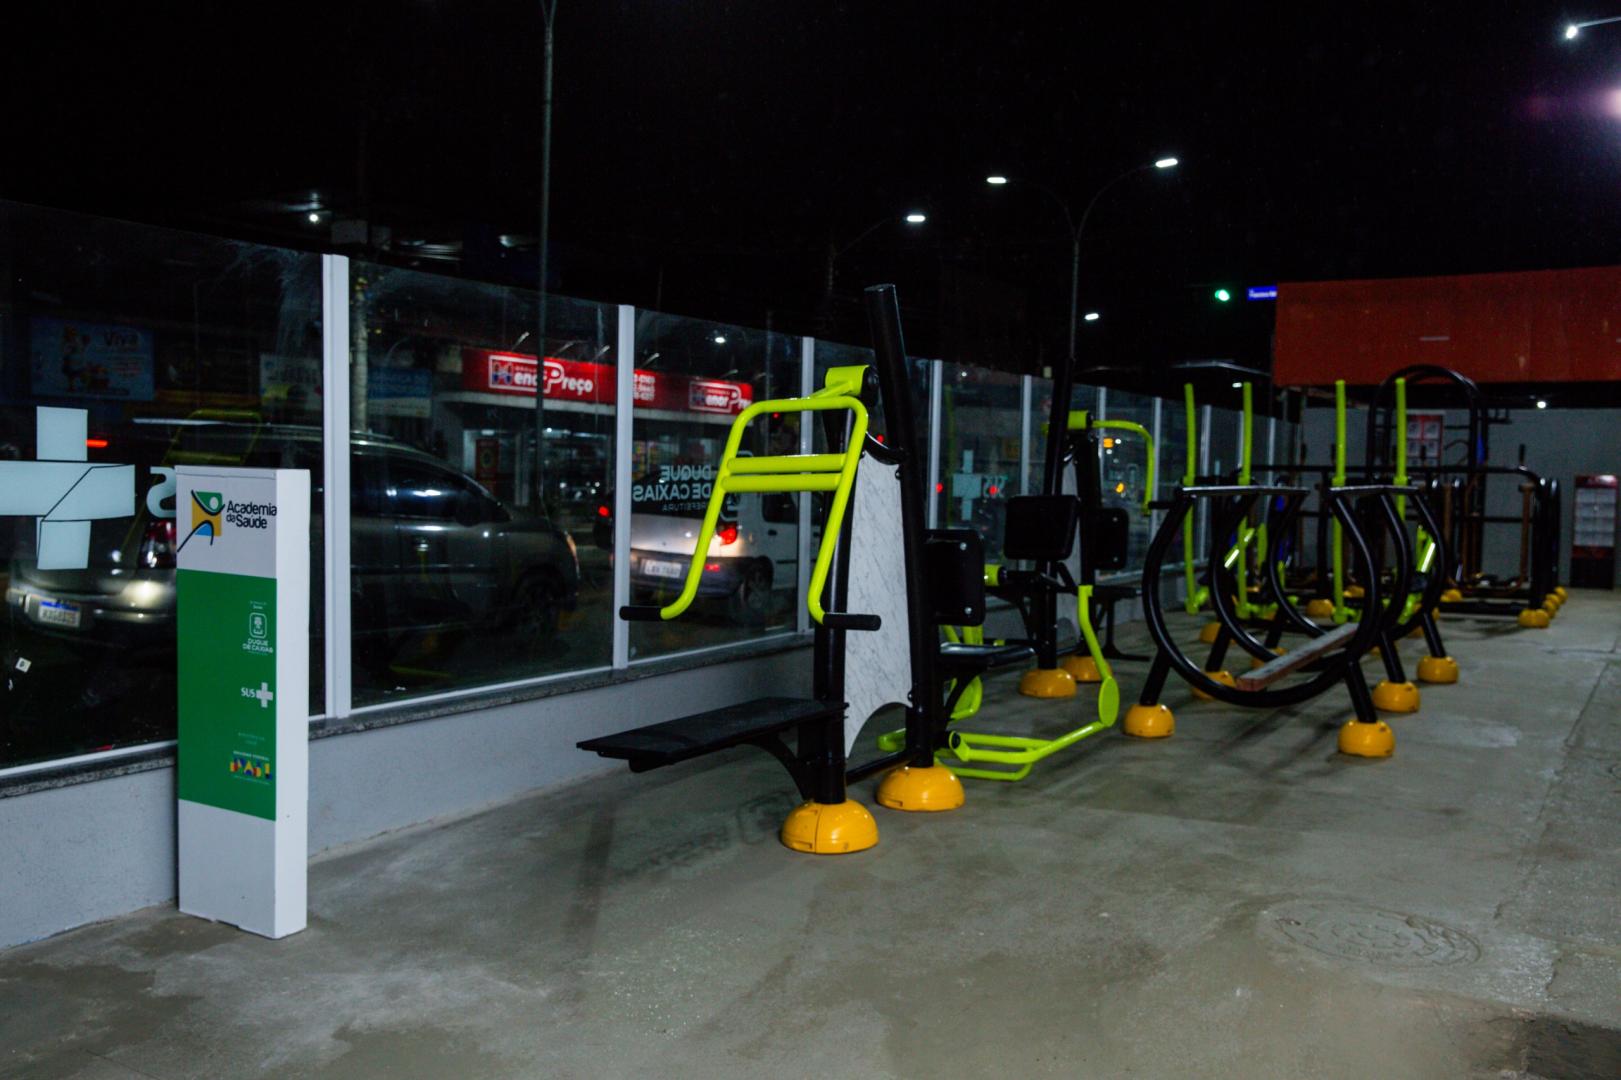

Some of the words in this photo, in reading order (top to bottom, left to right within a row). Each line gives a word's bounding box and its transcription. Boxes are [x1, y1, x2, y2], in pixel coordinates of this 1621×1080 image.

[227, 500, 277, 516] Academia
[225, 513, 236, 523] da
[235, 514, 267, 529] Saúde
[240, 687, 256, 699] SUS
